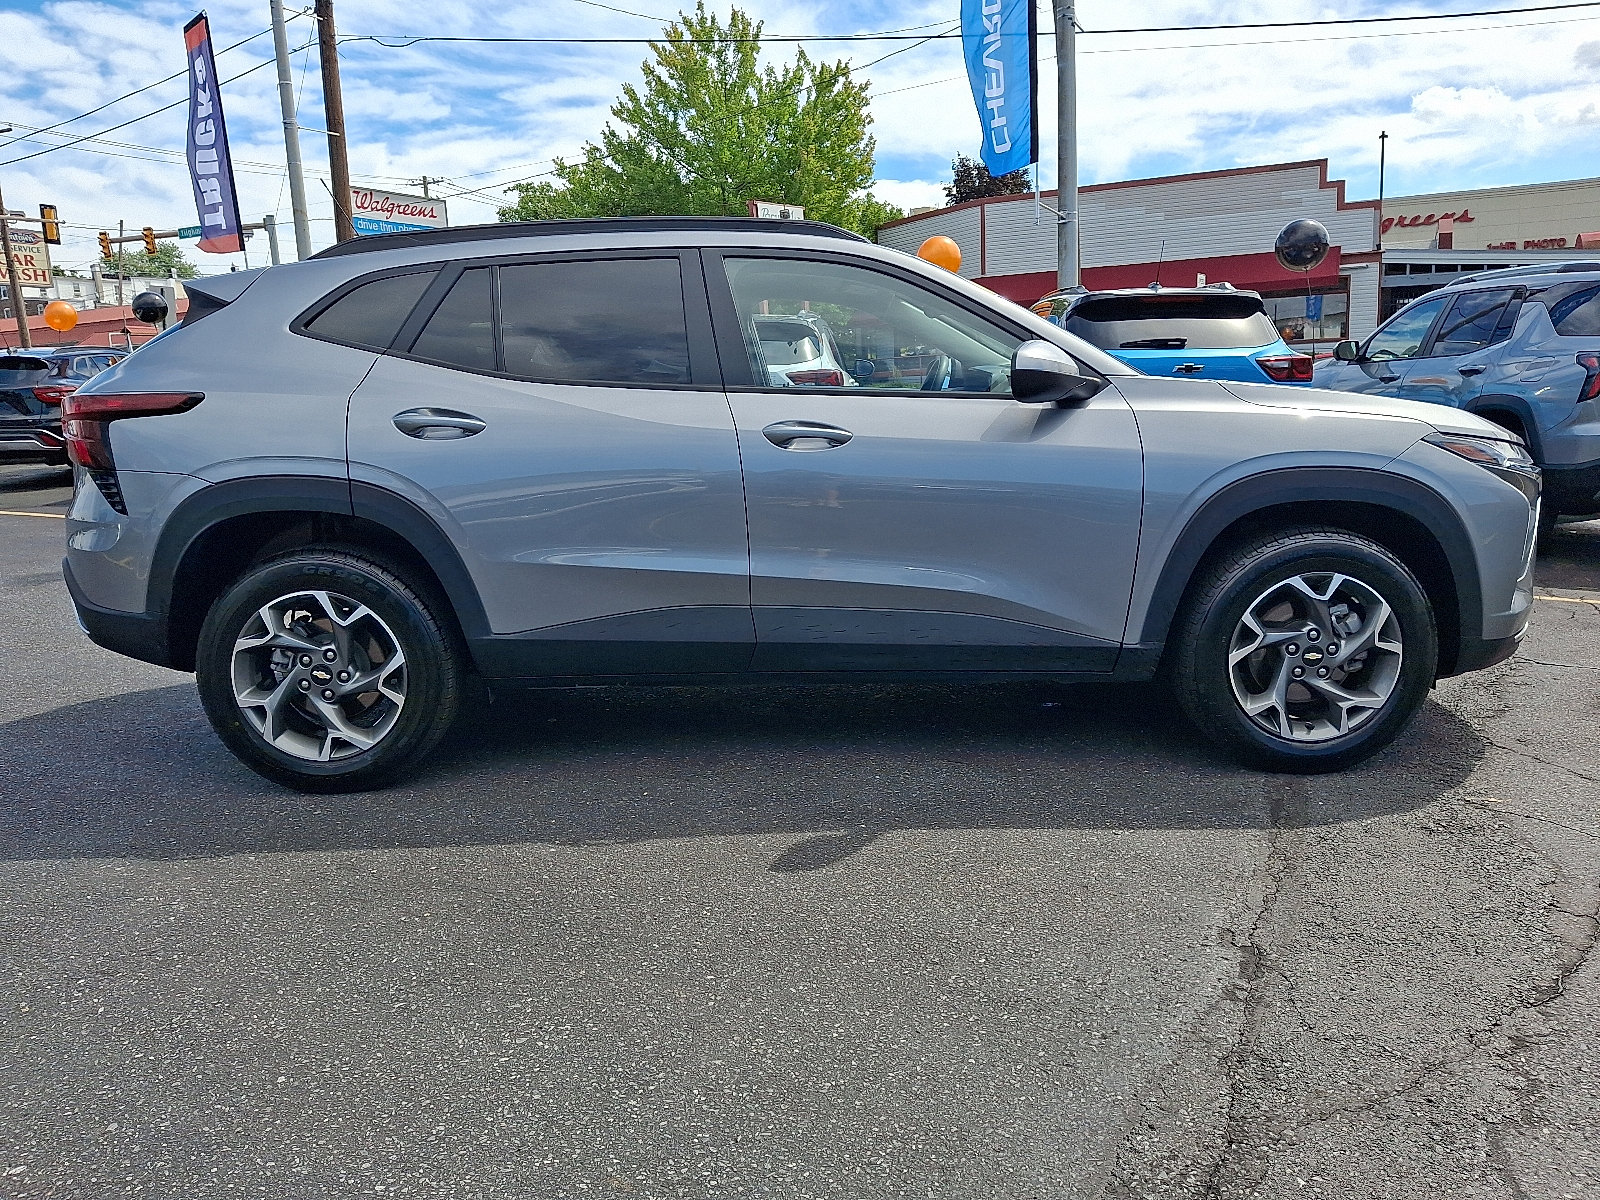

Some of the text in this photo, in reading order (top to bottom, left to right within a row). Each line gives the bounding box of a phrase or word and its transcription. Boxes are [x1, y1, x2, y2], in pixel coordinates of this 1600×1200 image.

[352, 190, 438, 220] Walgreens
[357, 219, 379, 231] drive
[379, 221, 397, 233] thru
[1523, 238, 1566, 249] PHOTO
[0, 268, 47, 281] WSH
